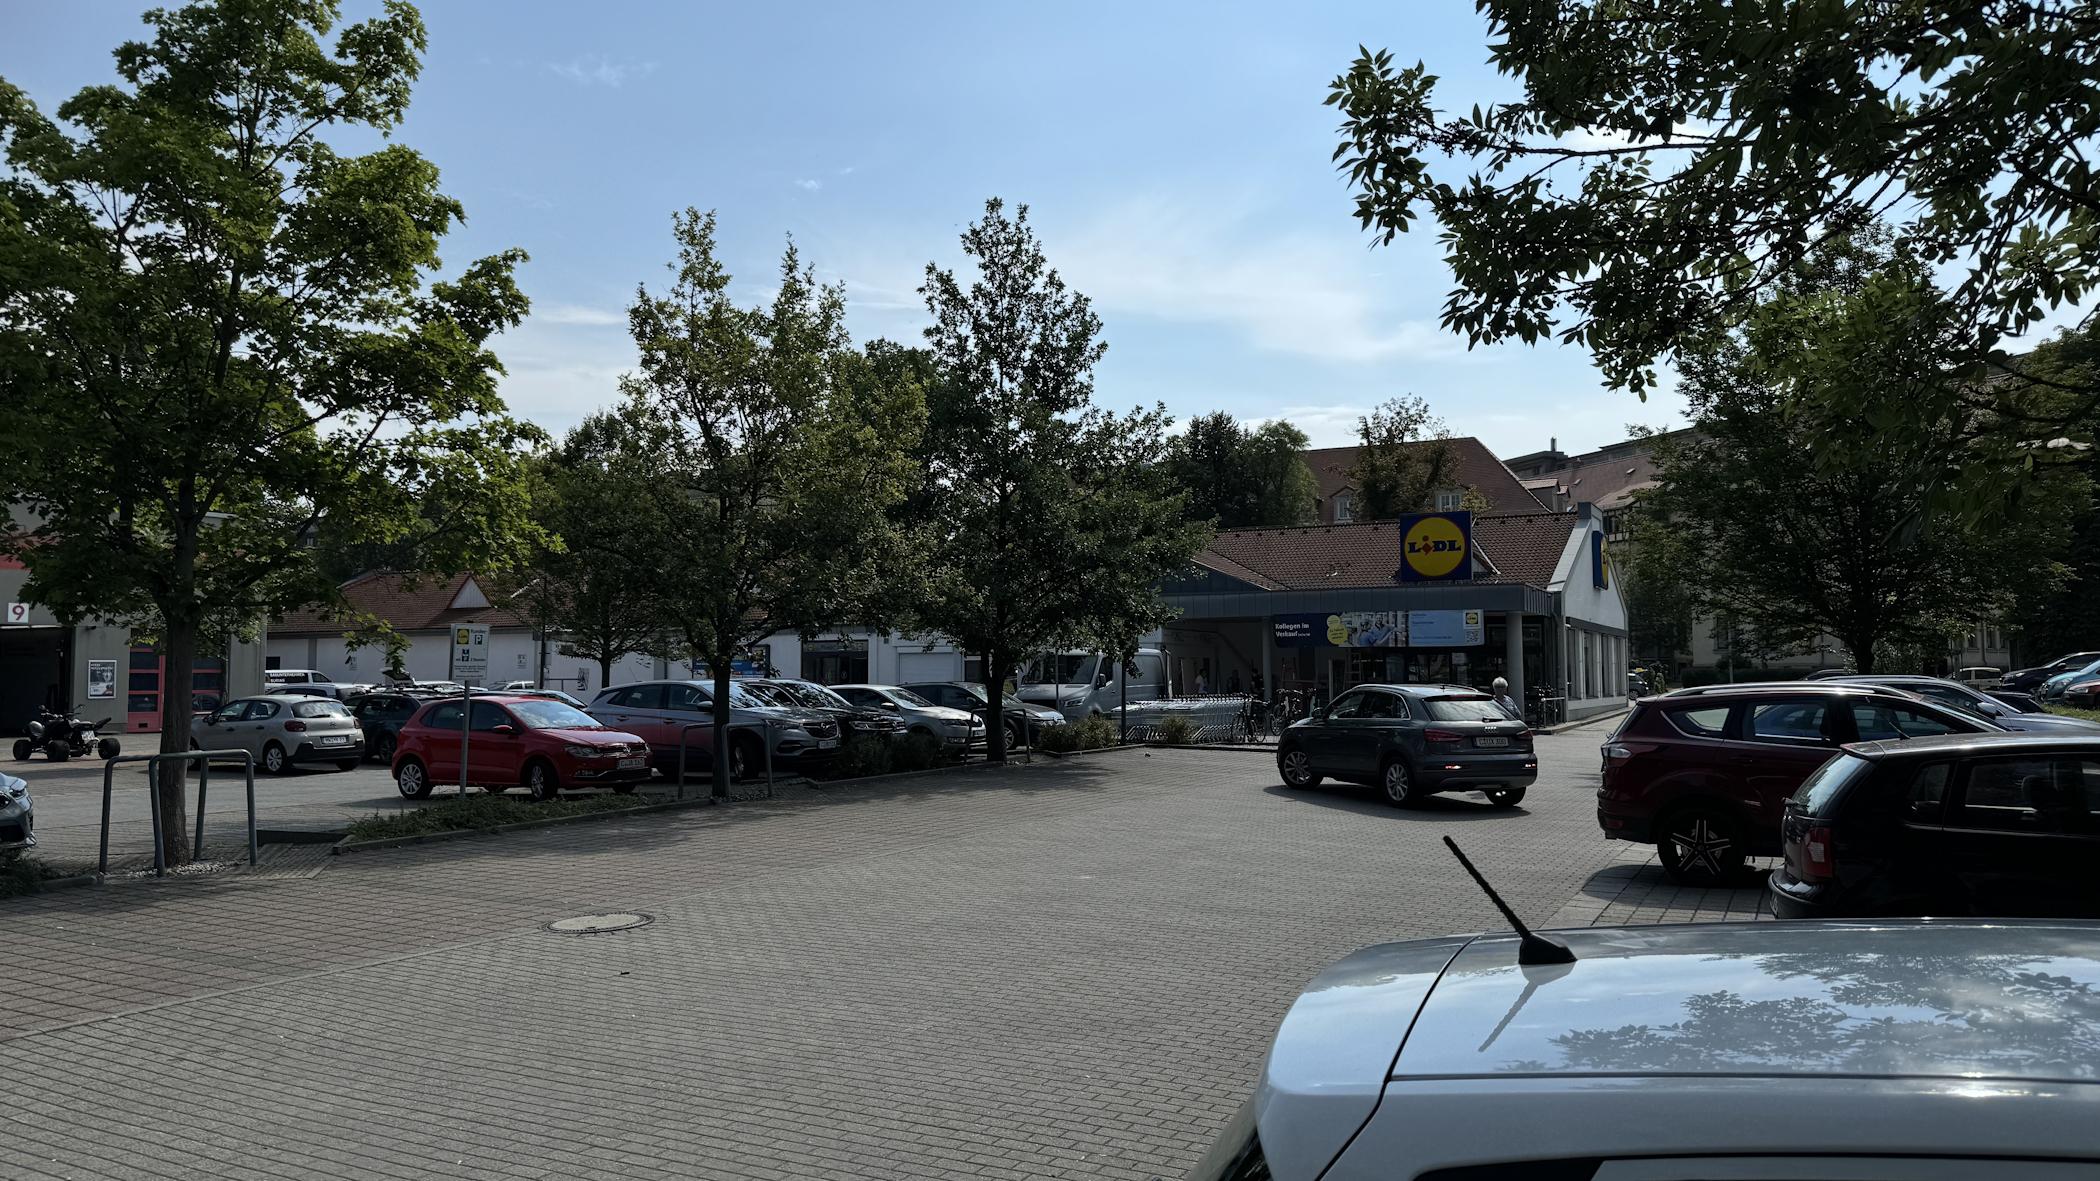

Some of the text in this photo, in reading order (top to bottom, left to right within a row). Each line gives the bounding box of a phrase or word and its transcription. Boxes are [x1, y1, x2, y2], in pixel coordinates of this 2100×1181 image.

[1407, 535, 1462, 556] LIDL
[12, 605, 25, 621] 9
[1275, 623, 1301, 631] Kollegen
[1275, 630, 1298, 638] Verkauf
